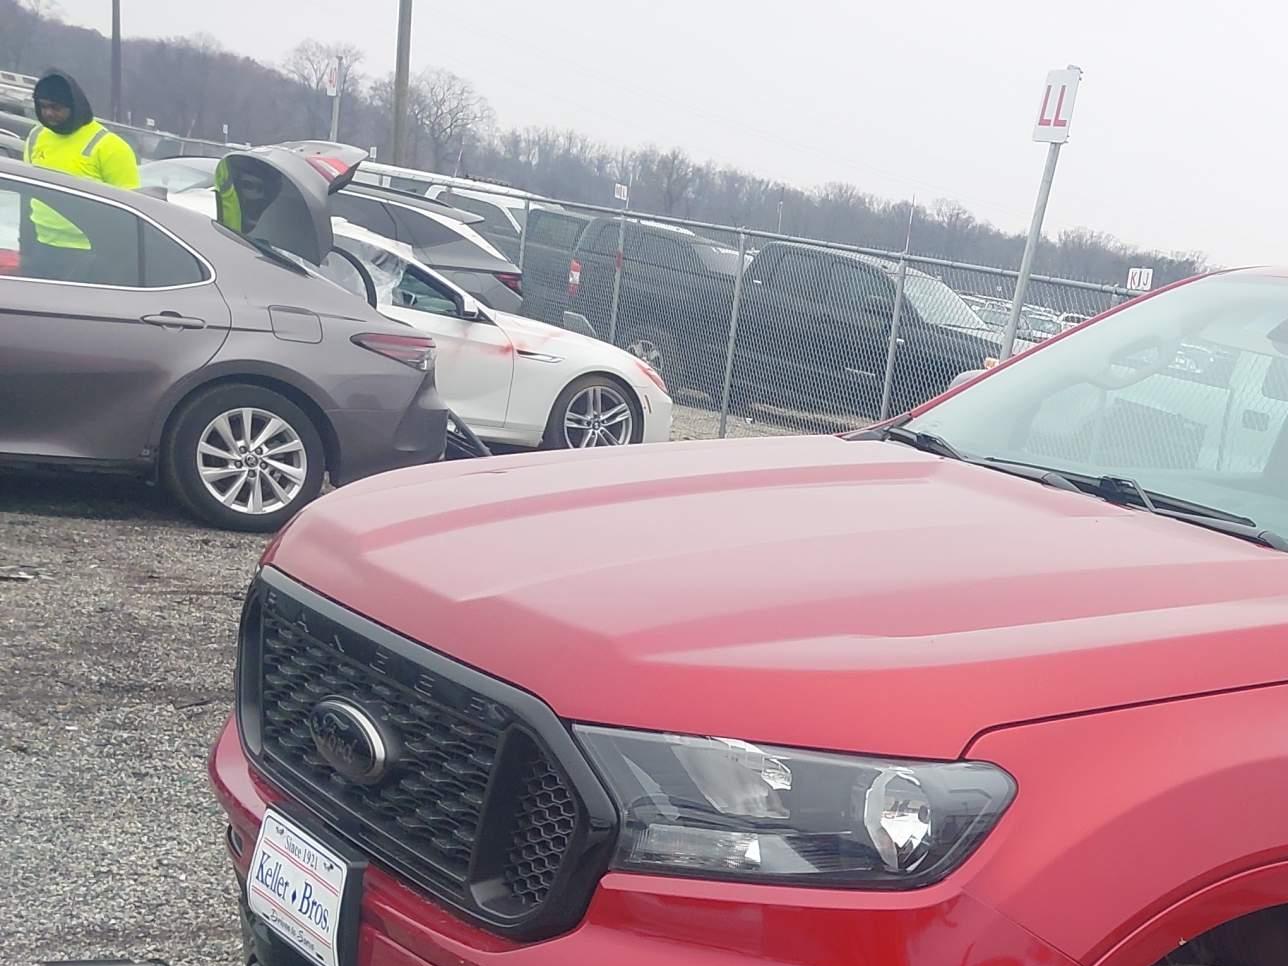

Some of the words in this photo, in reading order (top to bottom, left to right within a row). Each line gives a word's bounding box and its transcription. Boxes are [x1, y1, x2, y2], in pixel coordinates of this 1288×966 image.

[1038, 84, 1067, 127] LL
[285, 836, 303, 859] Since
[302, 847, 319, 871] 1921
[256, 851, 290, 901] Keller
[298, 881, 330, 933] Bros.
